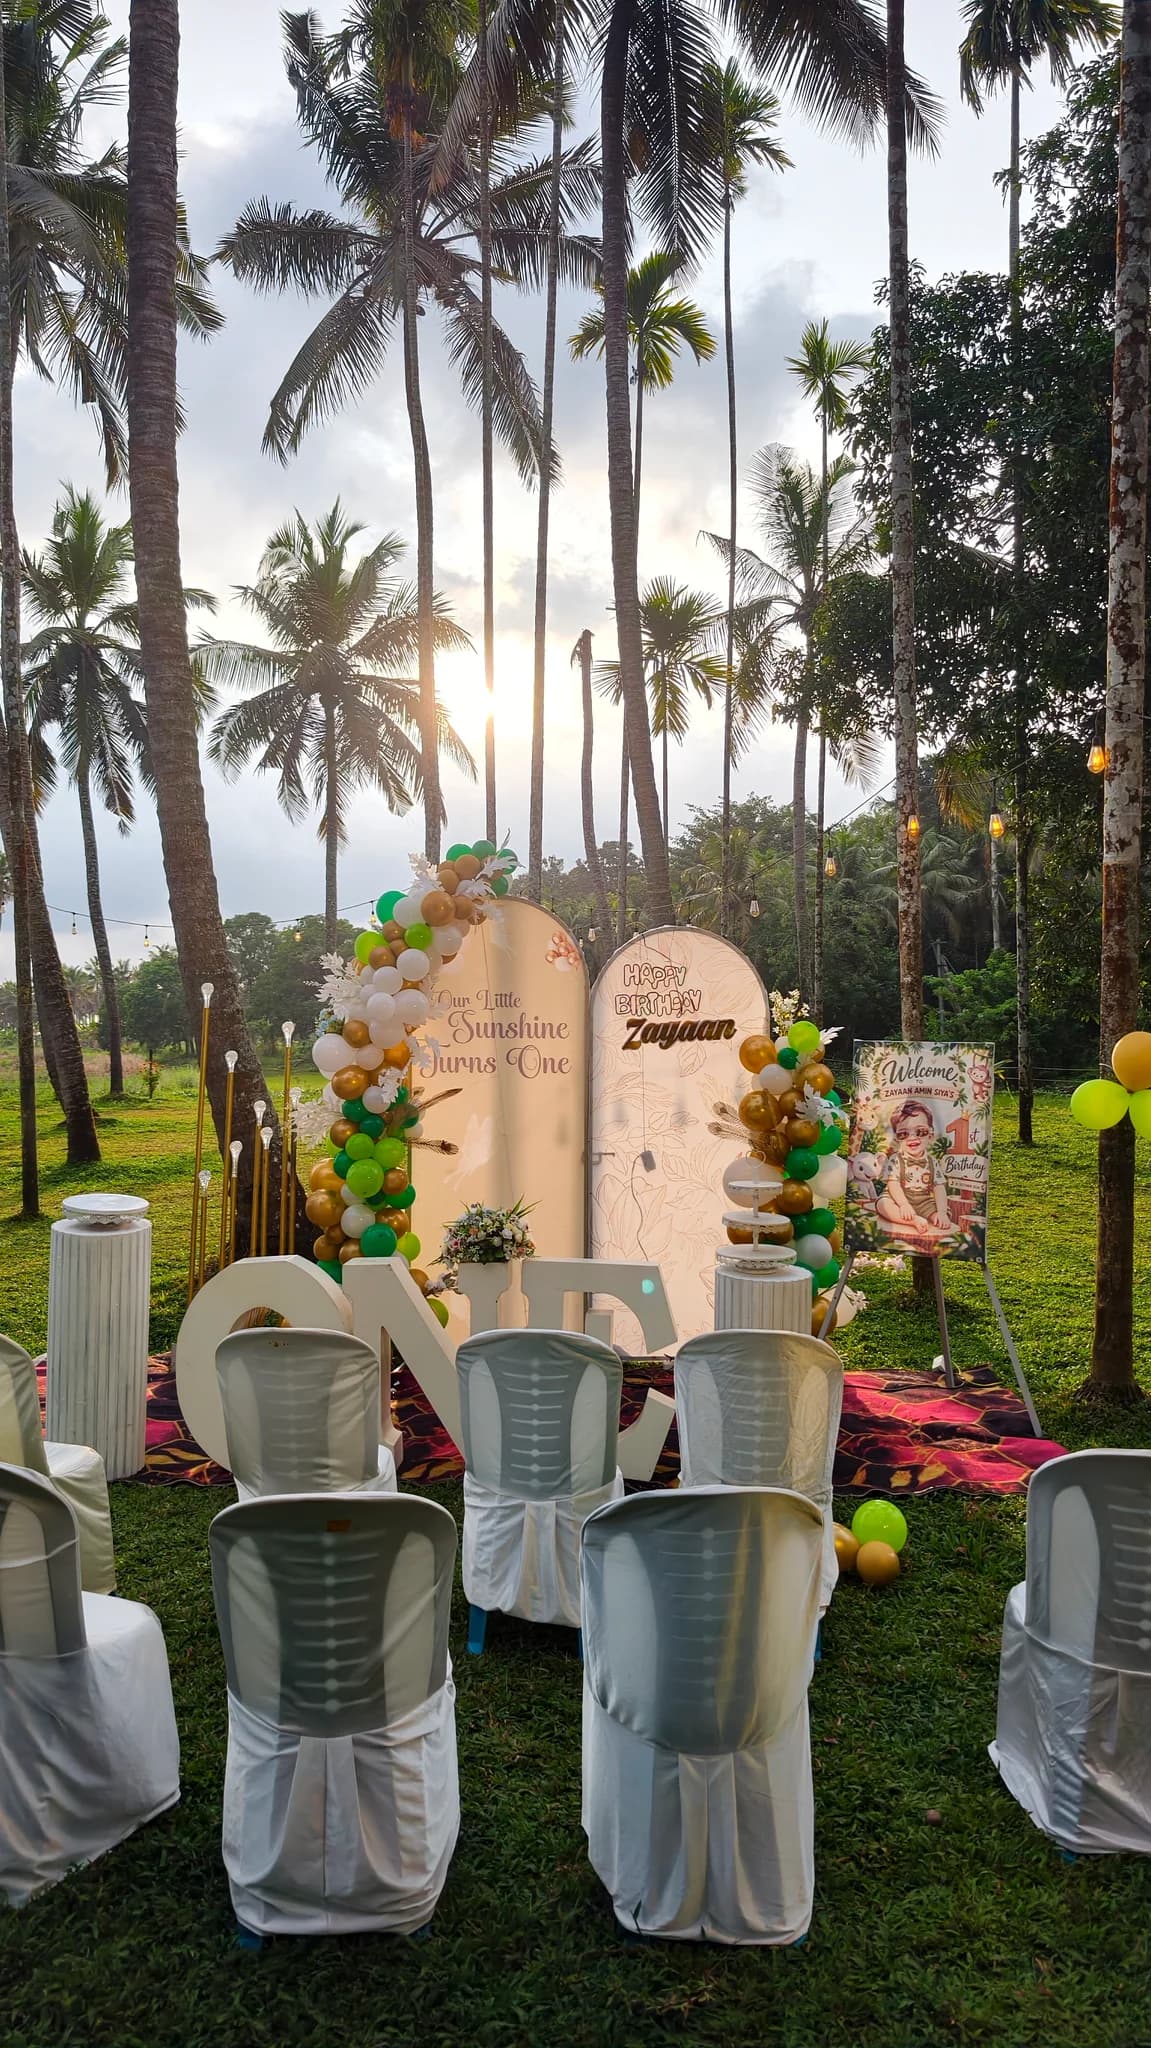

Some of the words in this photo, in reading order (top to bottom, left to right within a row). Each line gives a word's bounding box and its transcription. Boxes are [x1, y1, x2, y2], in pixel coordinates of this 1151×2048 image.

[623, 963, 686, 989] HAPPY
[476, 989, 521, 1011] Little
[615, 989, 702, 1018] BIRTHDAY
[447, 1009, 570, 1044] Sunshine
[622, 1018, 737, 1050] Zayaan
[506, 1044, 572, 1079] One
[882, 1055, 958, 1084] Welcome
[884, 1087, 912, 1097] ZAYAAN
[914, 1087, 932, 1095] AMIN
[945, 1156, 986, 1179] Birthday
